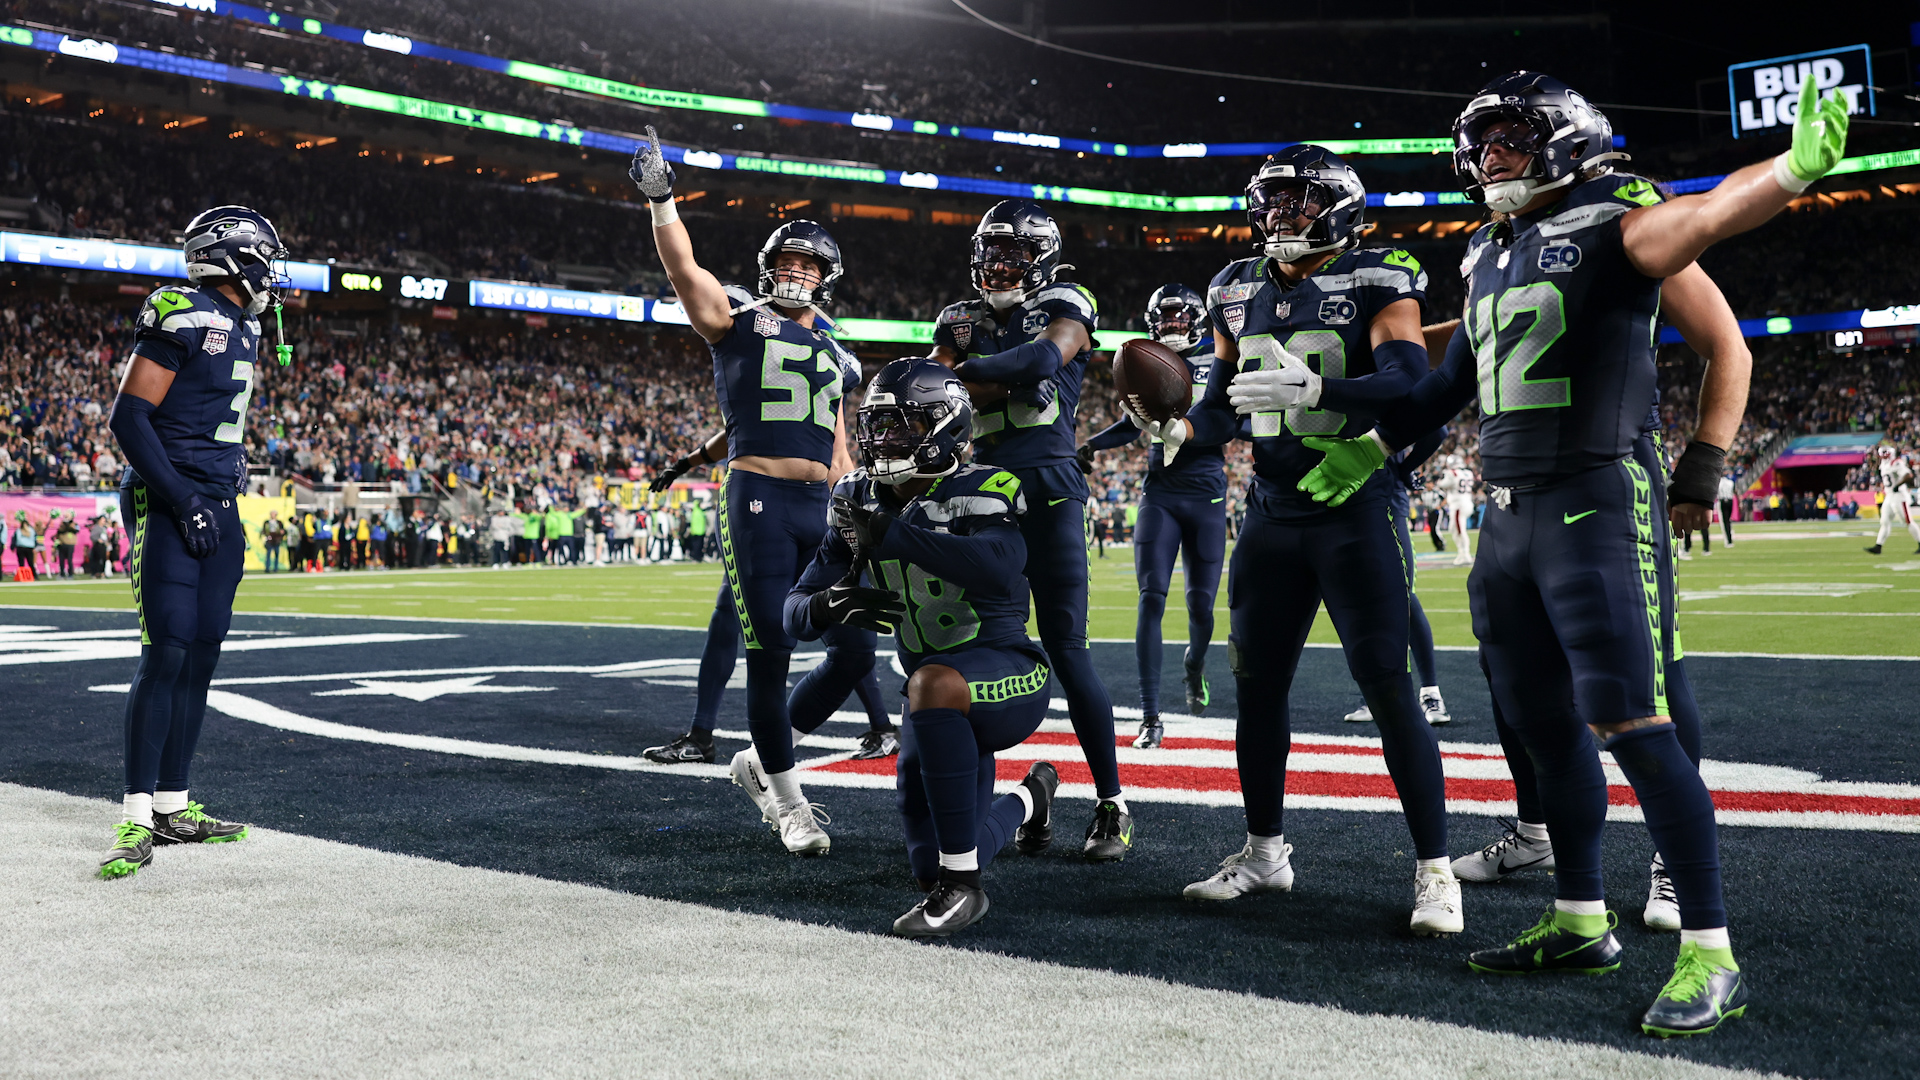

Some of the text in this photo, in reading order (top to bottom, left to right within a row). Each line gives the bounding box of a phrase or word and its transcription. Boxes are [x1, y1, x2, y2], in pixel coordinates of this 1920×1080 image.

[1753, 57, 1844, 99] BUD
[607, 84, 704, 105] SEAHAWKS
[454, 110, 482, 123] LX
[1738, 84, 1863, 131] LIGT
[736, 156, 886, 183] SEATTLE SEAHAWKS
[1551, 214, 1590, 228] SEAHAWKS
[103, 245, 137, 270] 19
[1539, 246, 1581, 269] 50
[341, 272, 383, 292] QTR 4
[400, 275, 448, 300] 8:37
[482, 285, 514, 306] 1ST
[526, 289, 549, 309] 10
[757, 315, 777, 326] USA
[1225, 308, 1243, 318] USA
[1319, 300, 1356, 321] 50
[756, 324, 779, 334] 250
[953, 327, 970, 335] USA
[1229, 320, 1243, 330] 250
[204, 341, 226, 351] 250
[207, 332, 226, 341] USA
[761, 339, 843, 433] 52
[214, 360, 254, 443] 3
